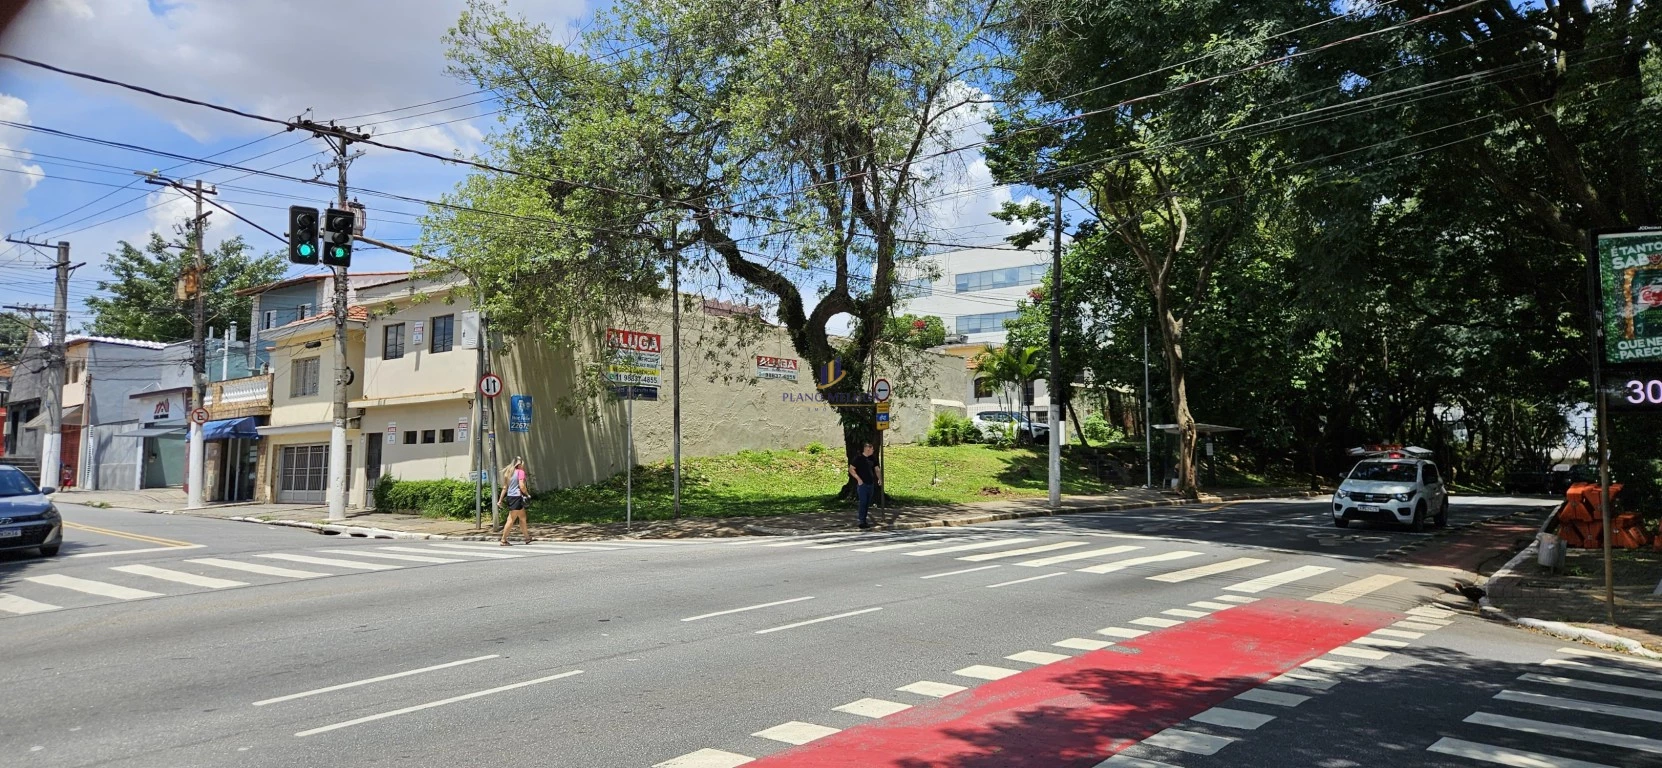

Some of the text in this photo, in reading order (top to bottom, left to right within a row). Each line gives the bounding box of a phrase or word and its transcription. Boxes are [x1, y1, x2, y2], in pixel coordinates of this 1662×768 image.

[1610, 241, 1662, 258] É TANTO
[1617, 338, 1645, 350] QUE
[1619, 345, 1662, 360] PAREC
[1626, 379, 1662, 404] 30
